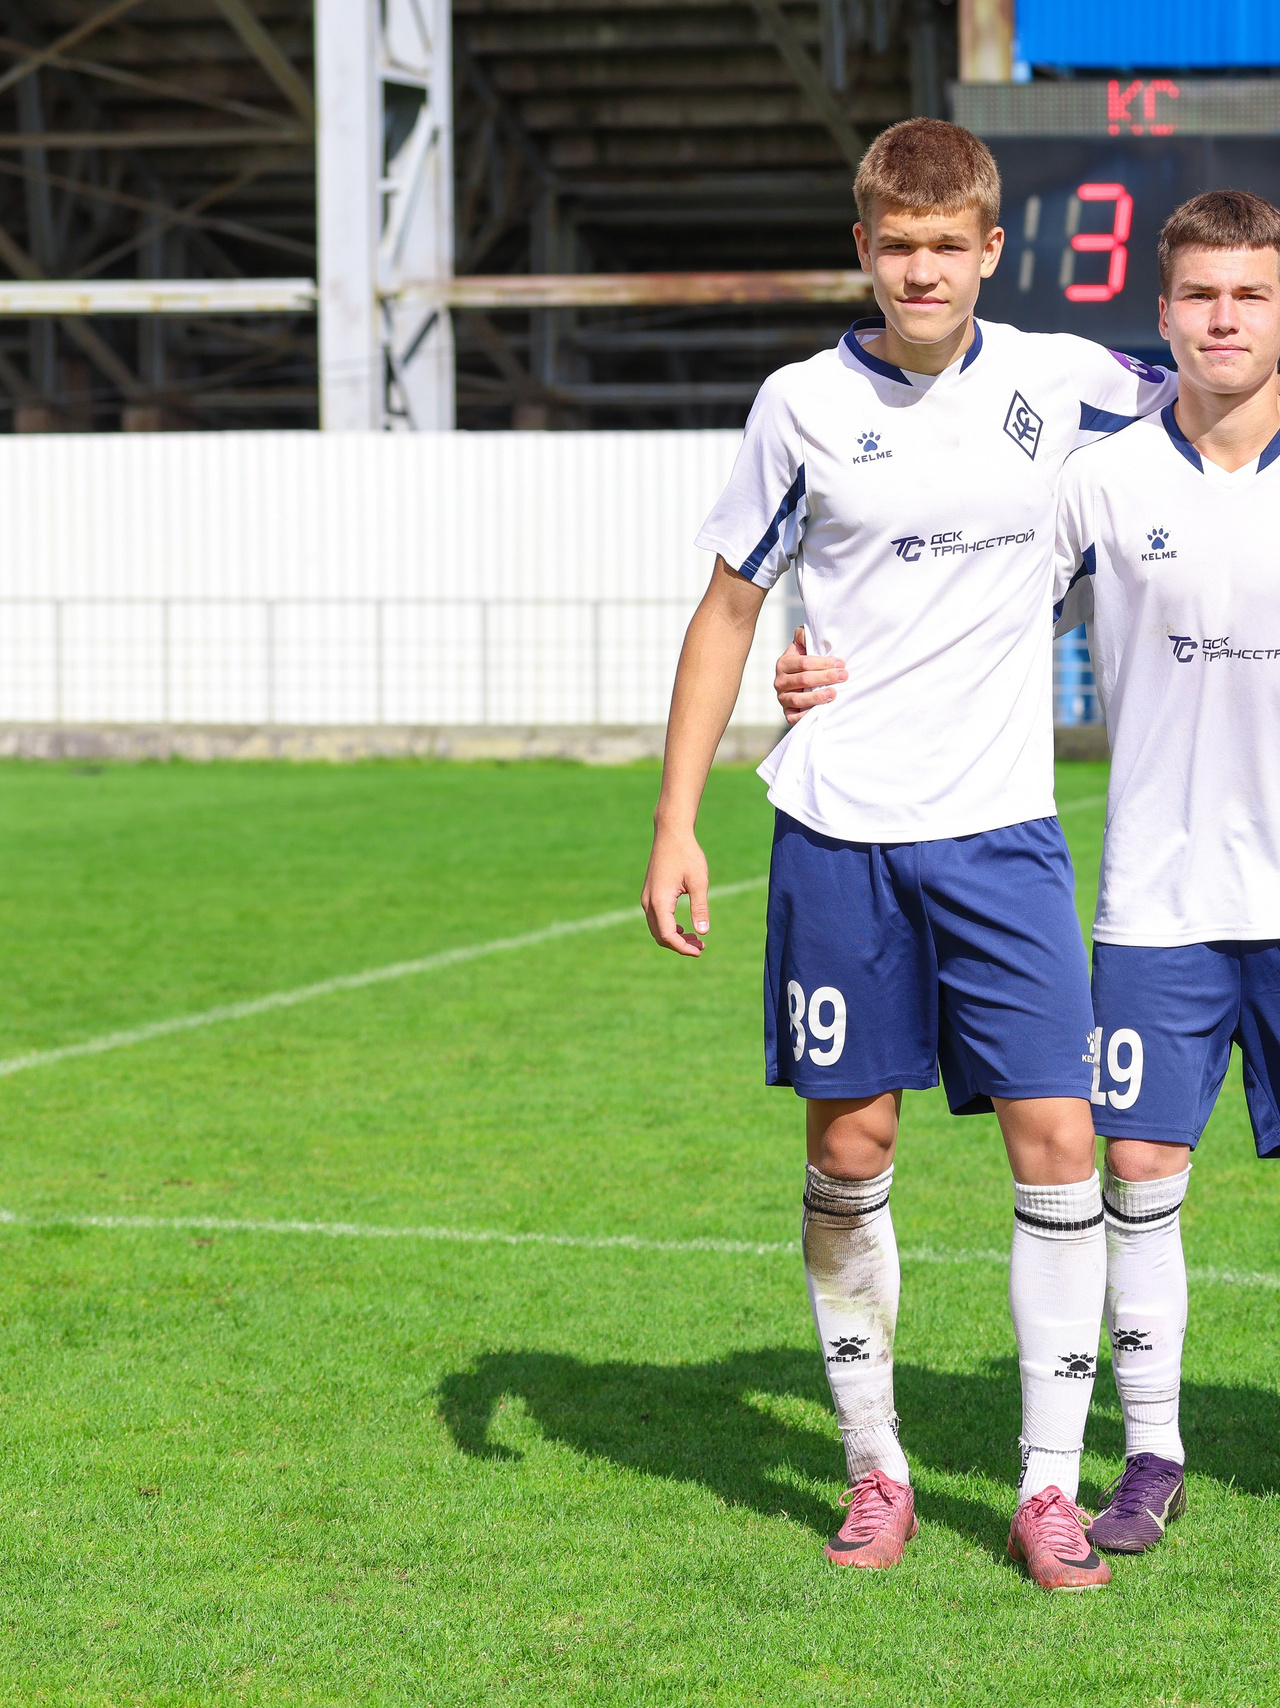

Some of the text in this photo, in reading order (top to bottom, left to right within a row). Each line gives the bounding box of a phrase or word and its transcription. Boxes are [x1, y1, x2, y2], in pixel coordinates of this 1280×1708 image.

[1107, 79, 1180, 136] КС
[852, 450, 893, 464] KELME
[930, 531, 963, 545] ДСК
[930, 528, 1035, 557] ТРАНССТРОЙ
[1141, 550, 1177, 561] KELME
[1202, 636, 1230, 649] ДСК
[786, 979, 847, 1067] 89
[1112, 1343, 1153, 1352] KELME
[826, 1352, 870, 1363] KELME
[1054, 1369, 1096, 1380] KELME
